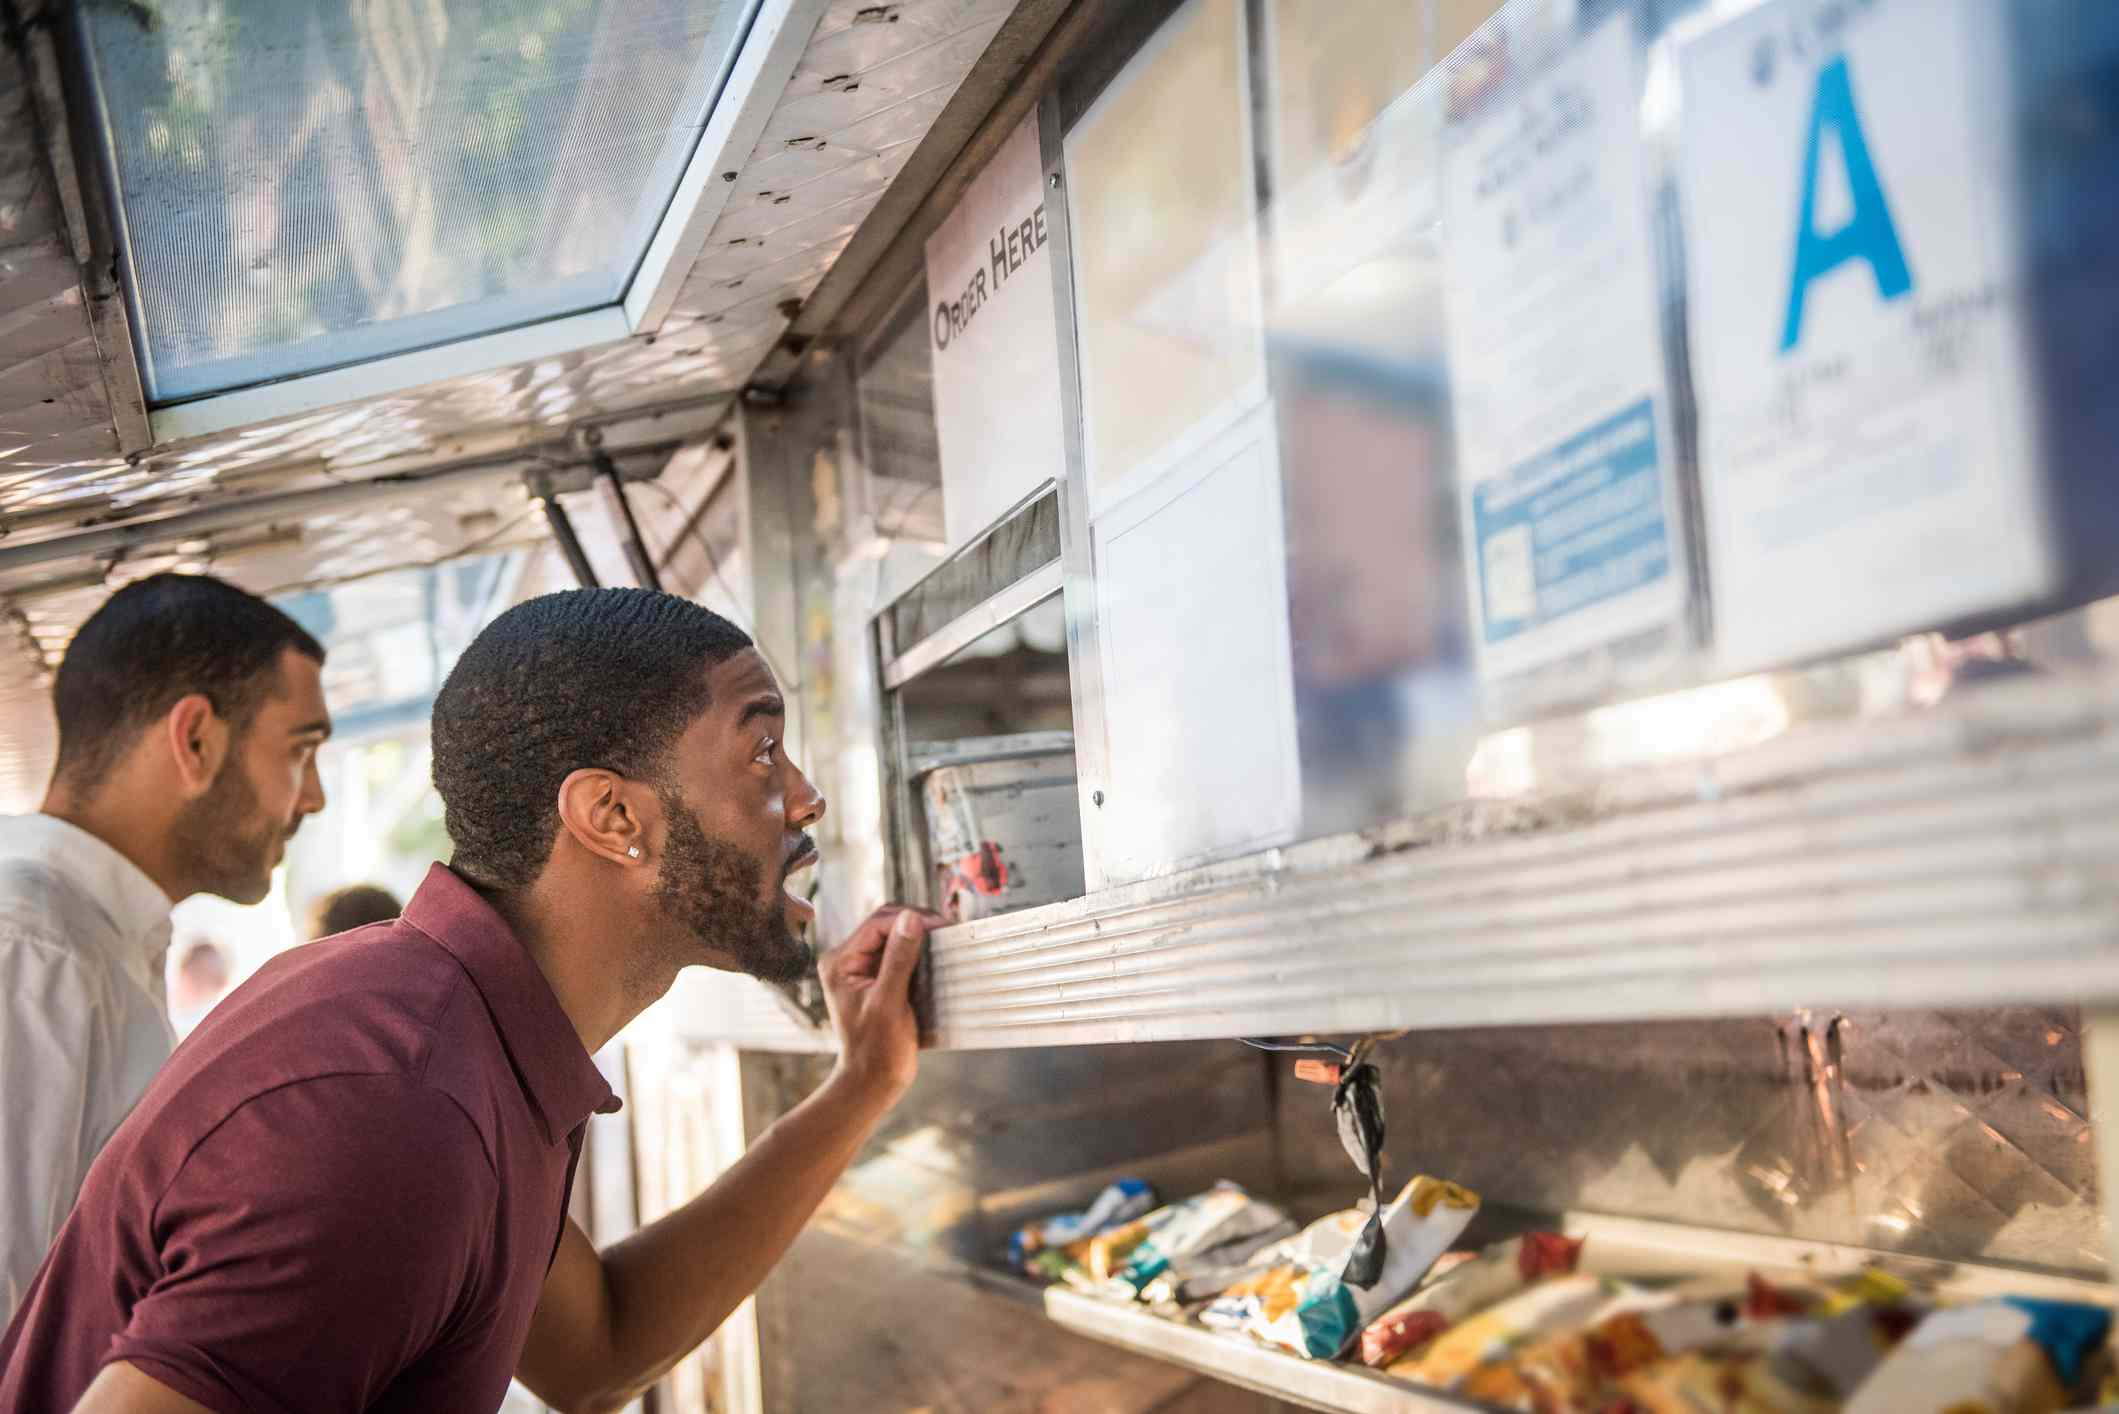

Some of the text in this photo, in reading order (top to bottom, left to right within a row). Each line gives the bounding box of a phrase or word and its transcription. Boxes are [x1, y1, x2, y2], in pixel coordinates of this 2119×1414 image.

[934, 203, 1048, 350] ORDER HERE
[1777, 53, 1913, 355] A
